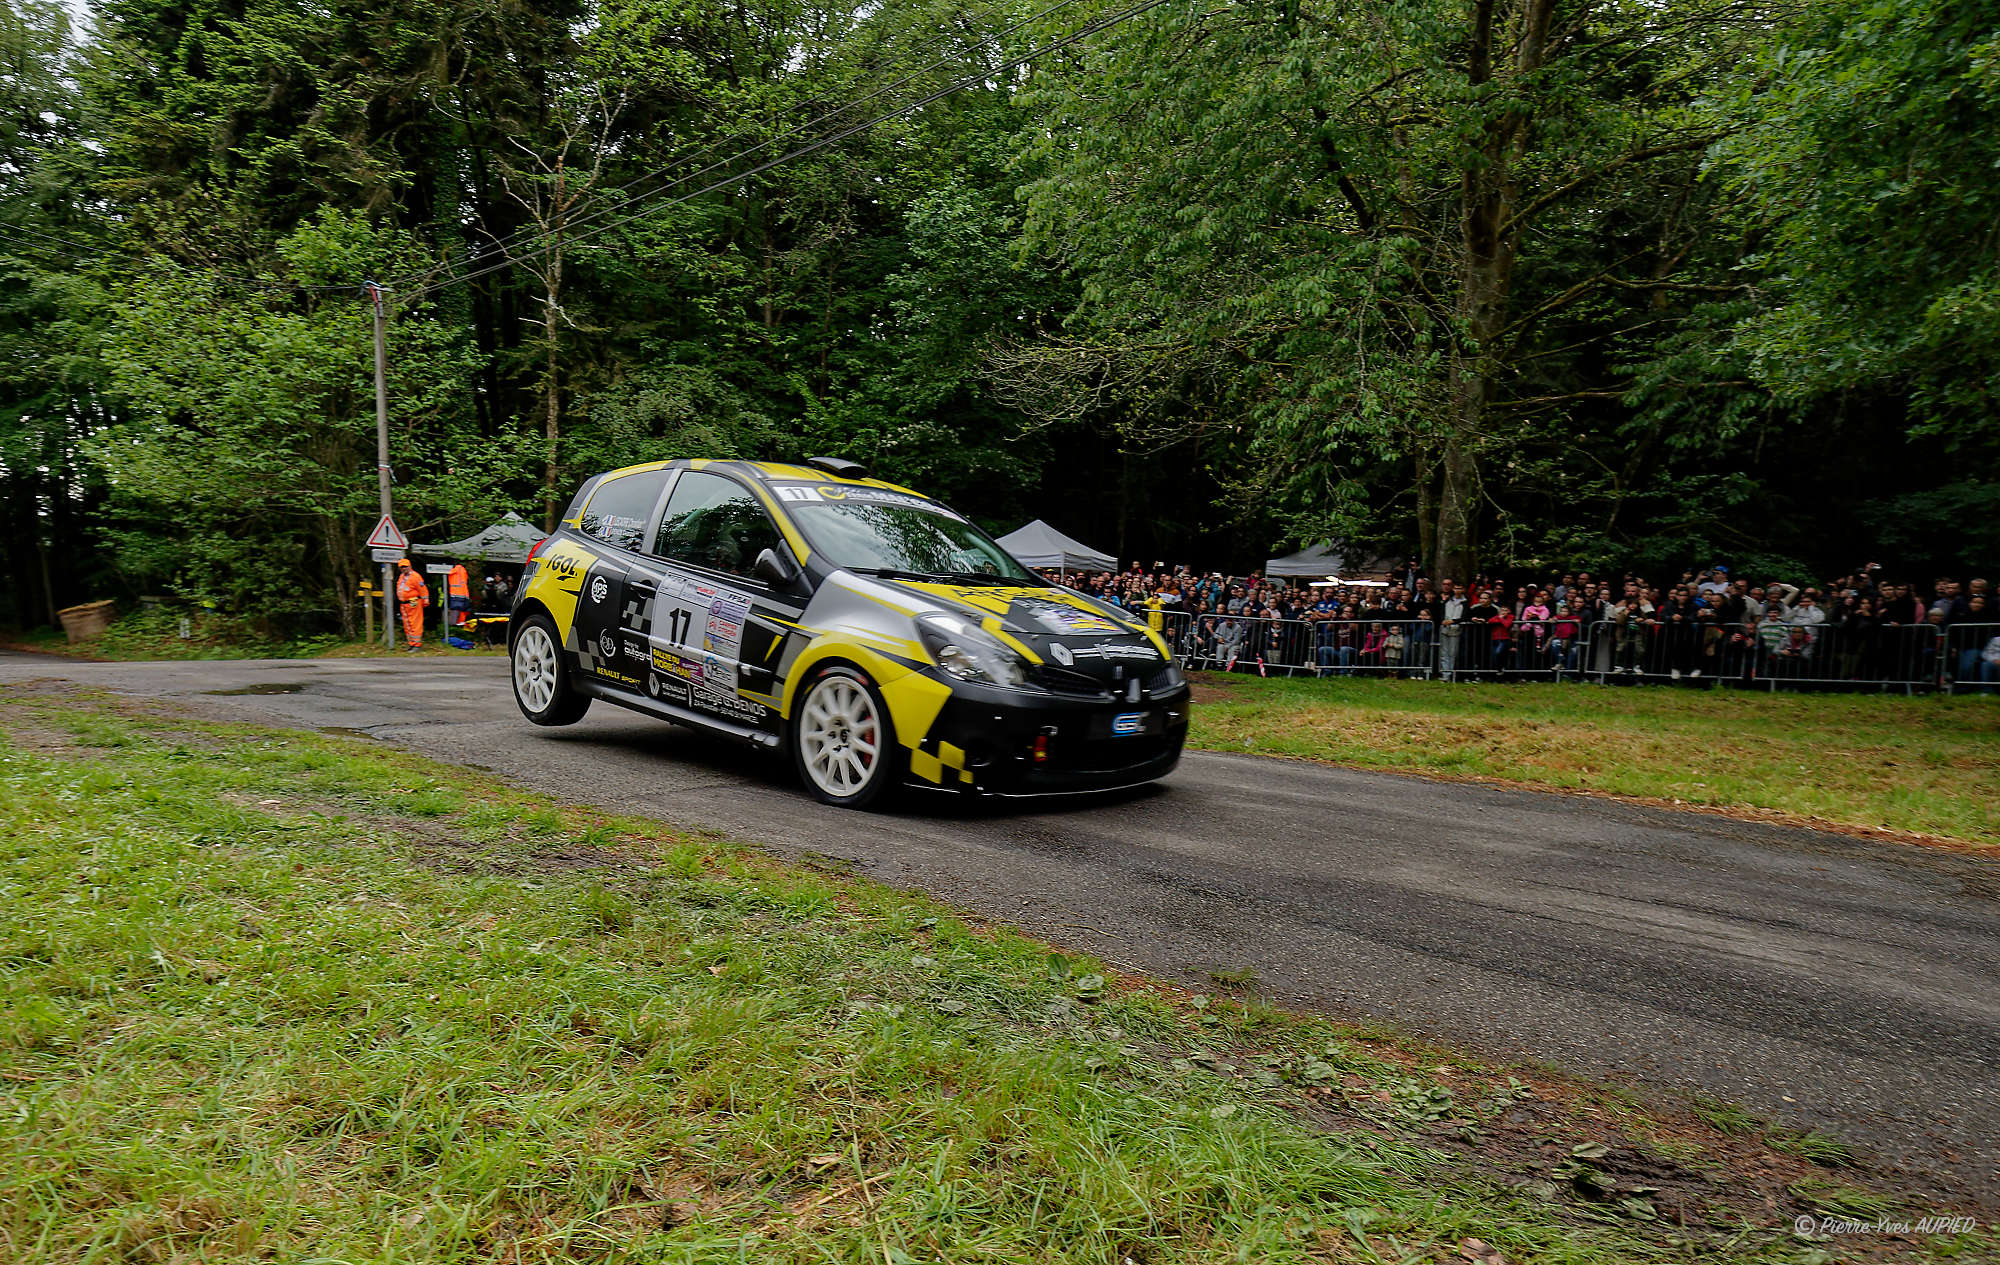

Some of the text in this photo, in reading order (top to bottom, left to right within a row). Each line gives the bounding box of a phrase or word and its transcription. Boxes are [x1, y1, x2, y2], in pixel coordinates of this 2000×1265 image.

[787, 487, 809, 499] 17
[546, 554, 578, 577] IGOL
[669, 608, 692, 650] 17
[597, 666, 621, 680] RENAULT
[693, 687, 723, 706] Garage
